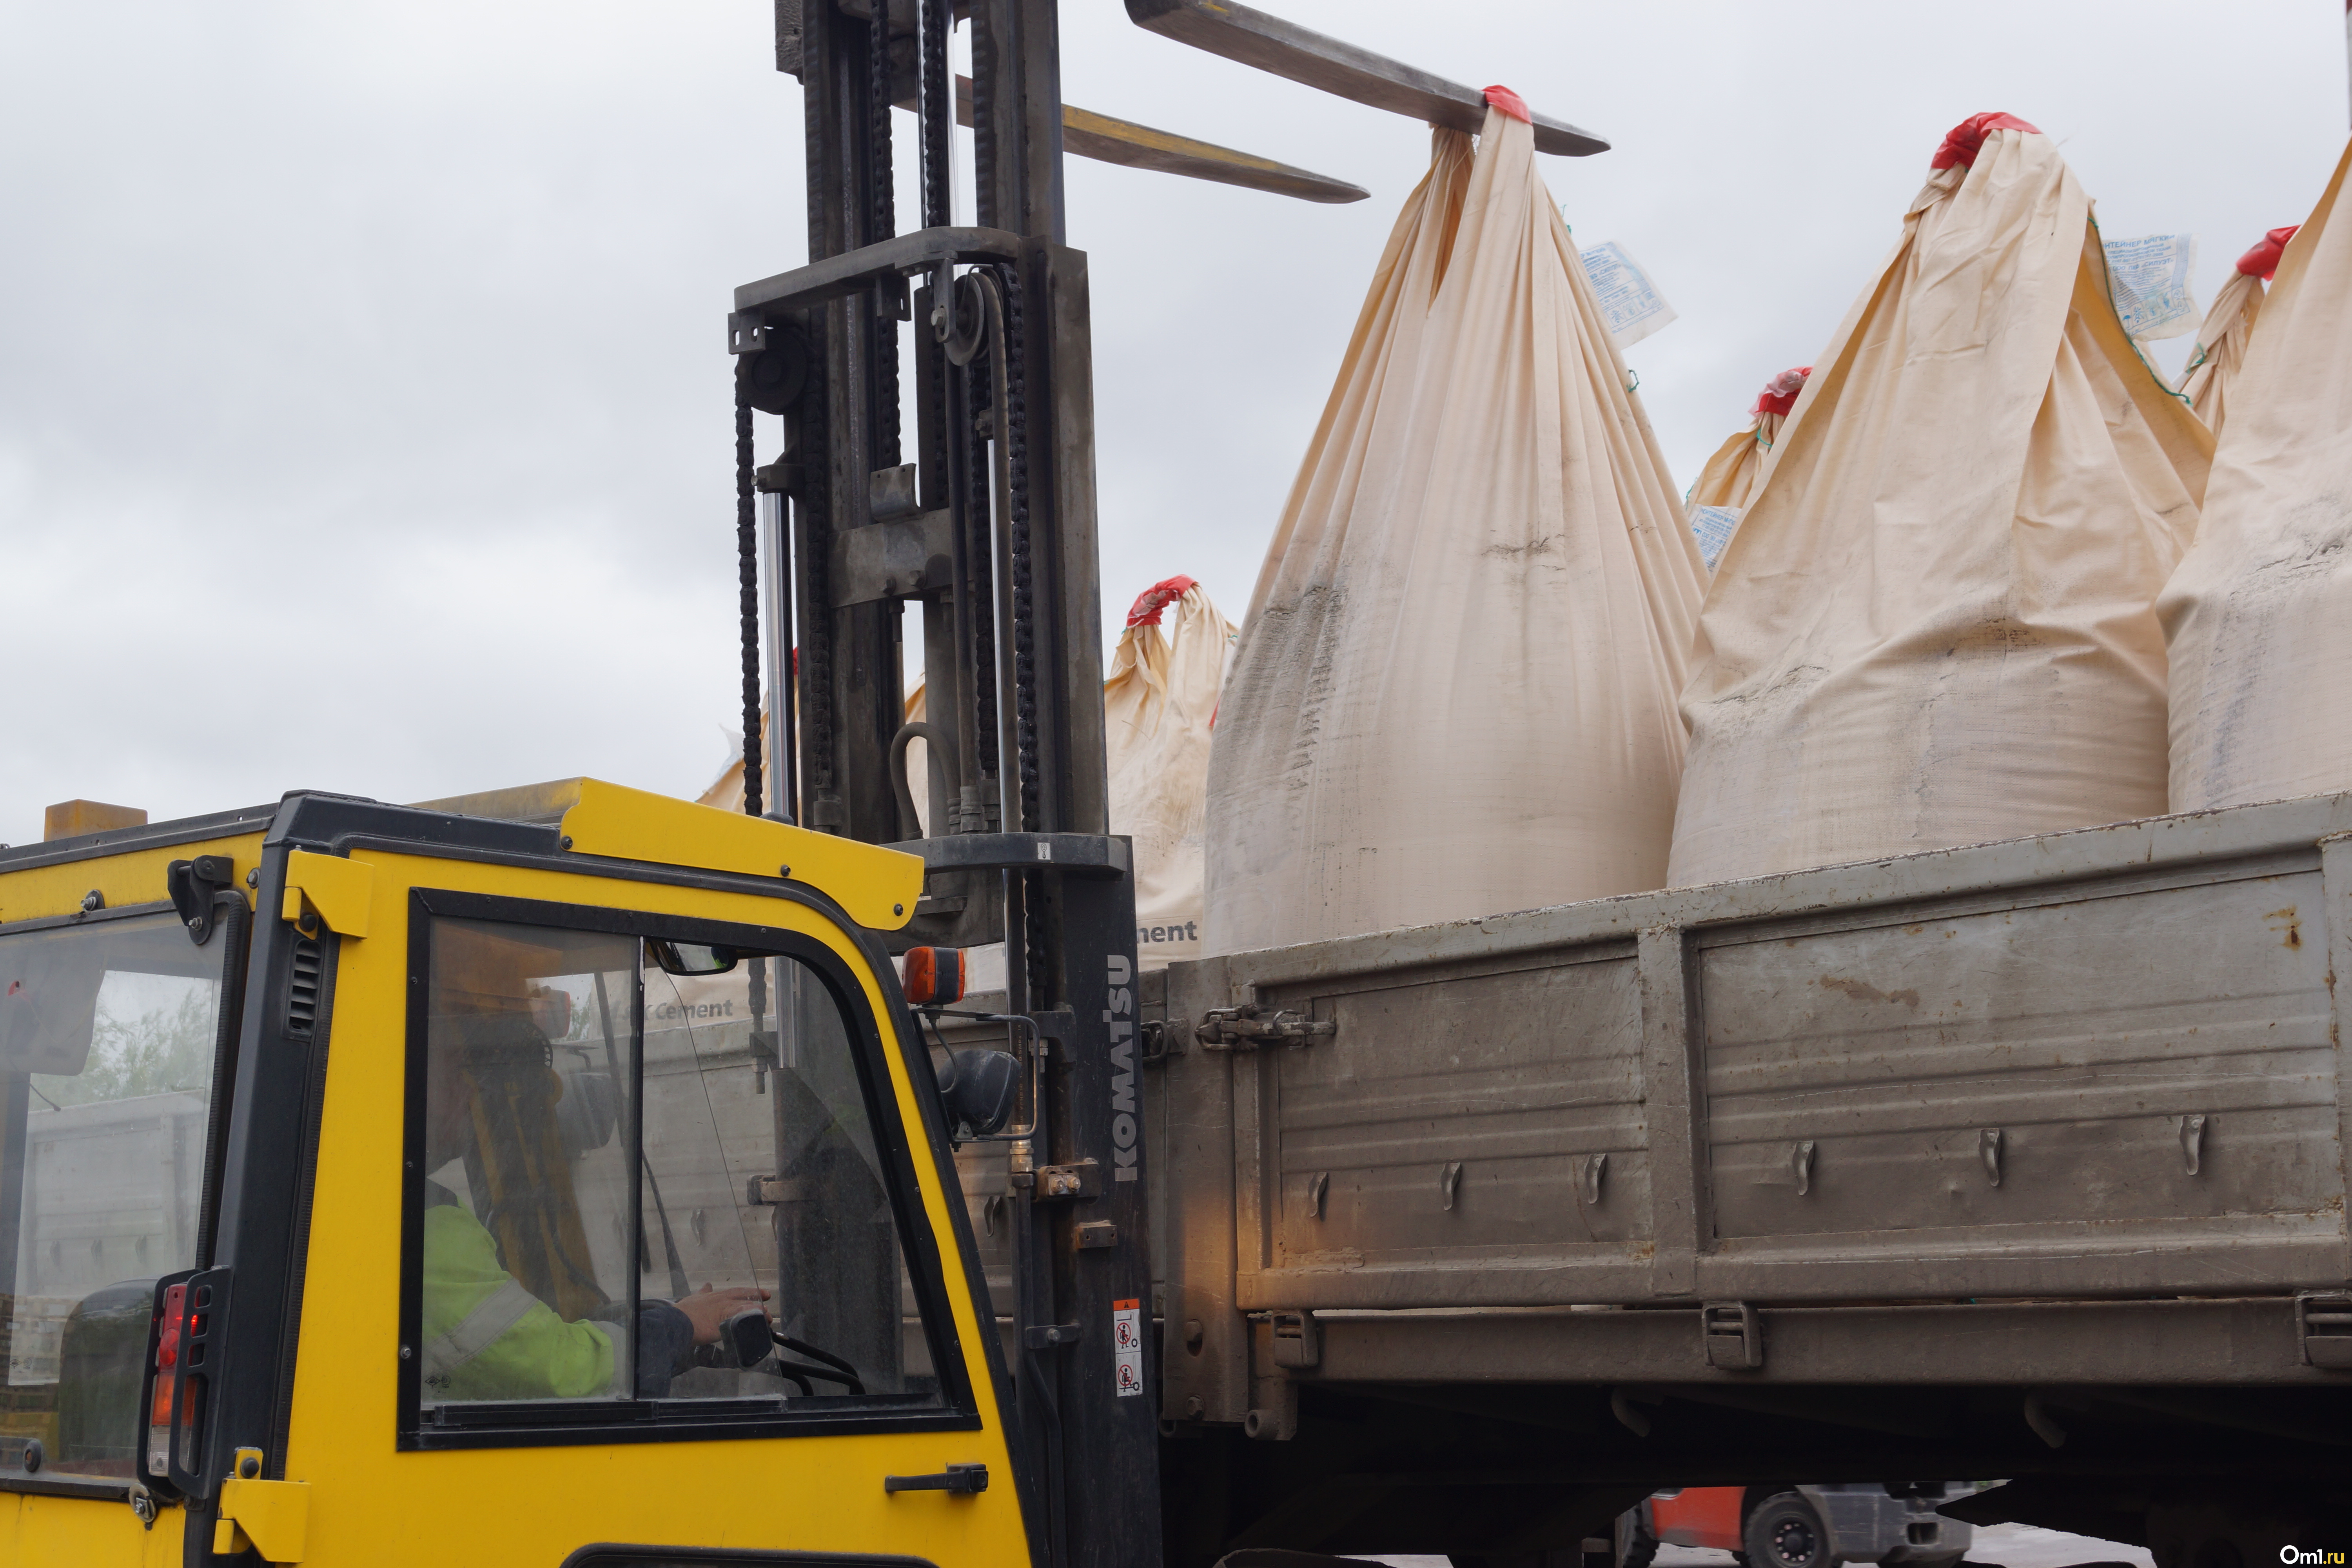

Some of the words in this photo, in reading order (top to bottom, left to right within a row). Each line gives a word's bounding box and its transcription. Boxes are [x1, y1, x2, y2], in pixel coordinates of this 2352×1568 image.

[2103, 240, 2141, 249] НТЕЙНЕР
[655, 999, 733, 1021] Cement
[1103, 955, 1138, 1182] KOMATSU
